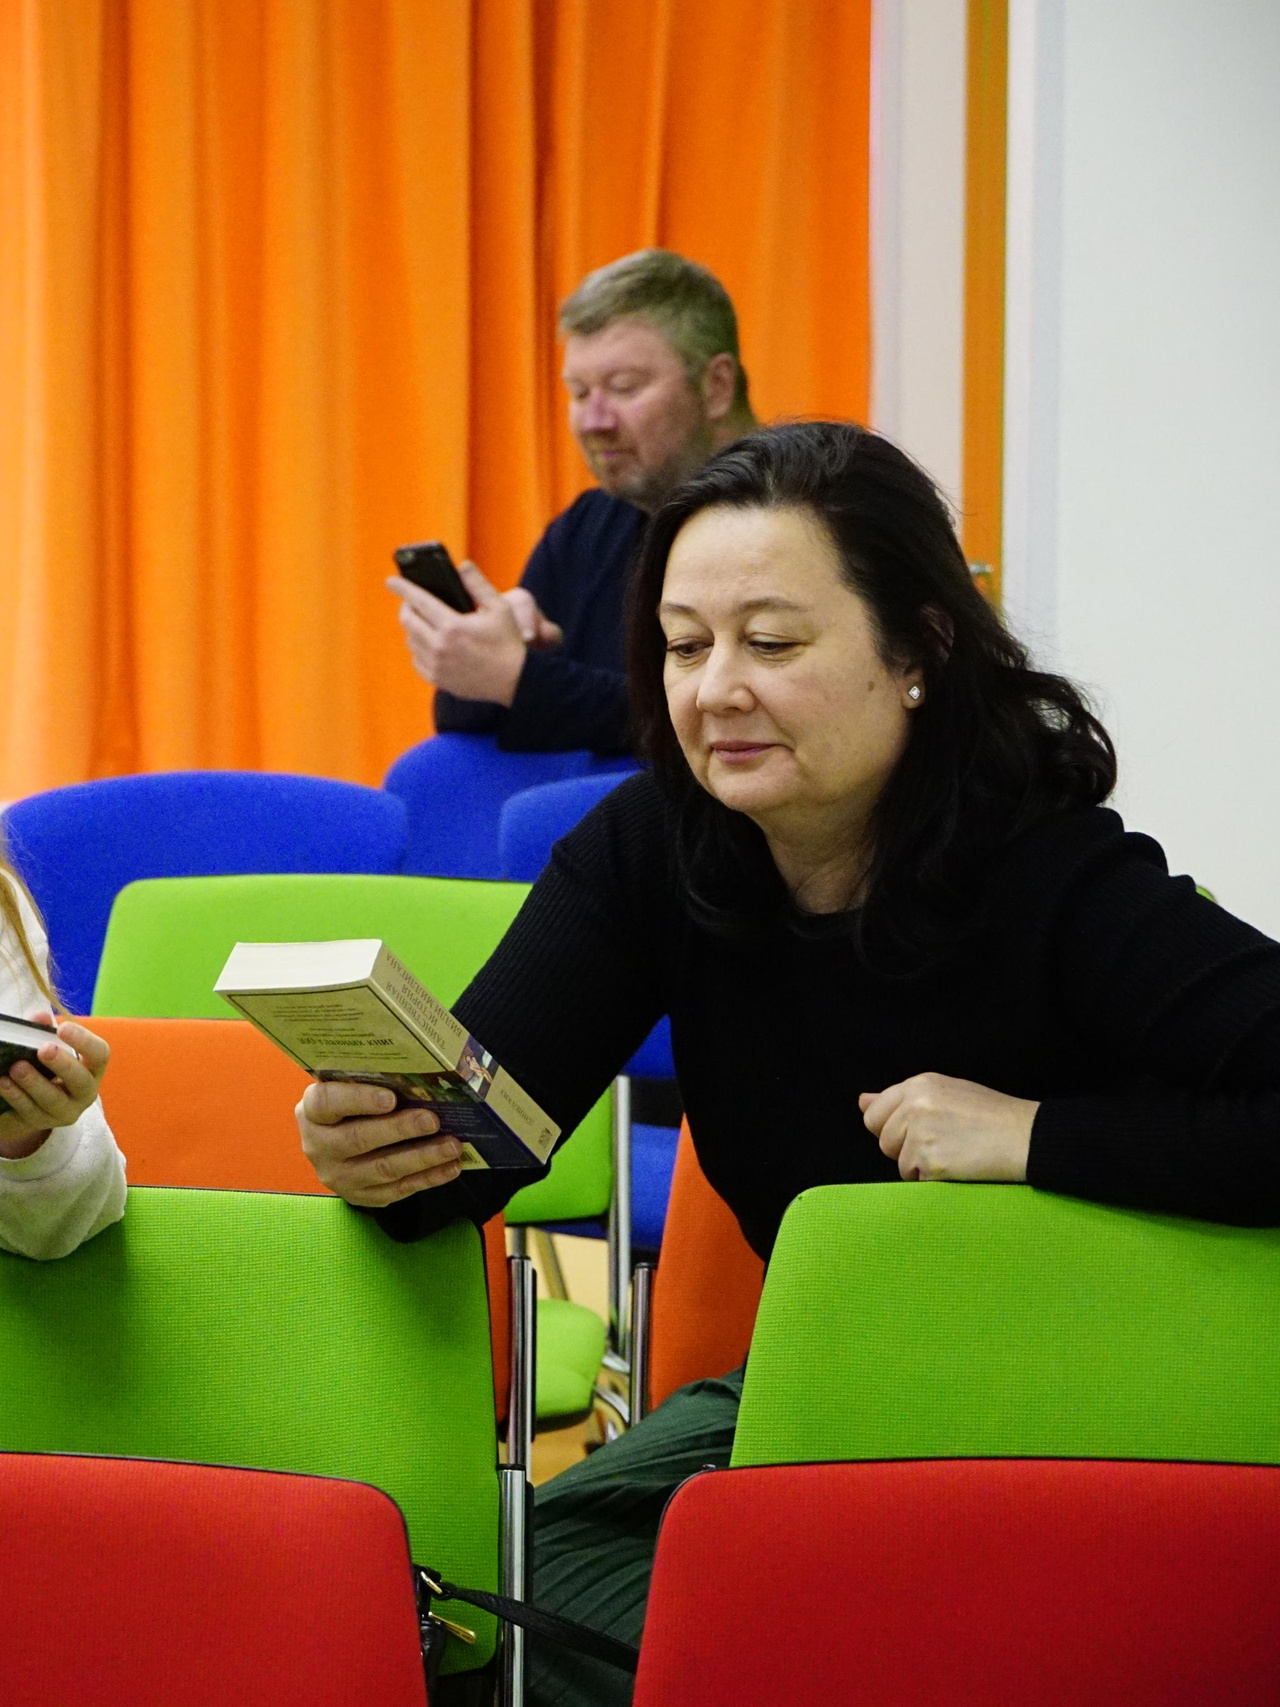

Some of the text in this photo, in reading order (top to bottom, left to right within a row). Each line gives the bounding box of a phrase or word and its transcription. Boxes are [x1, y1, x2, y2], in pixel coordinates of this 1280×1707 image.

[386, 953, 463, 1038] БИЛЛИ МИЛЛИГАНА
[386, 981, 445, 1050] ТАИНСТВЕННАЯ
[401, 984, 438, 1027] ИСТОРИЯ
